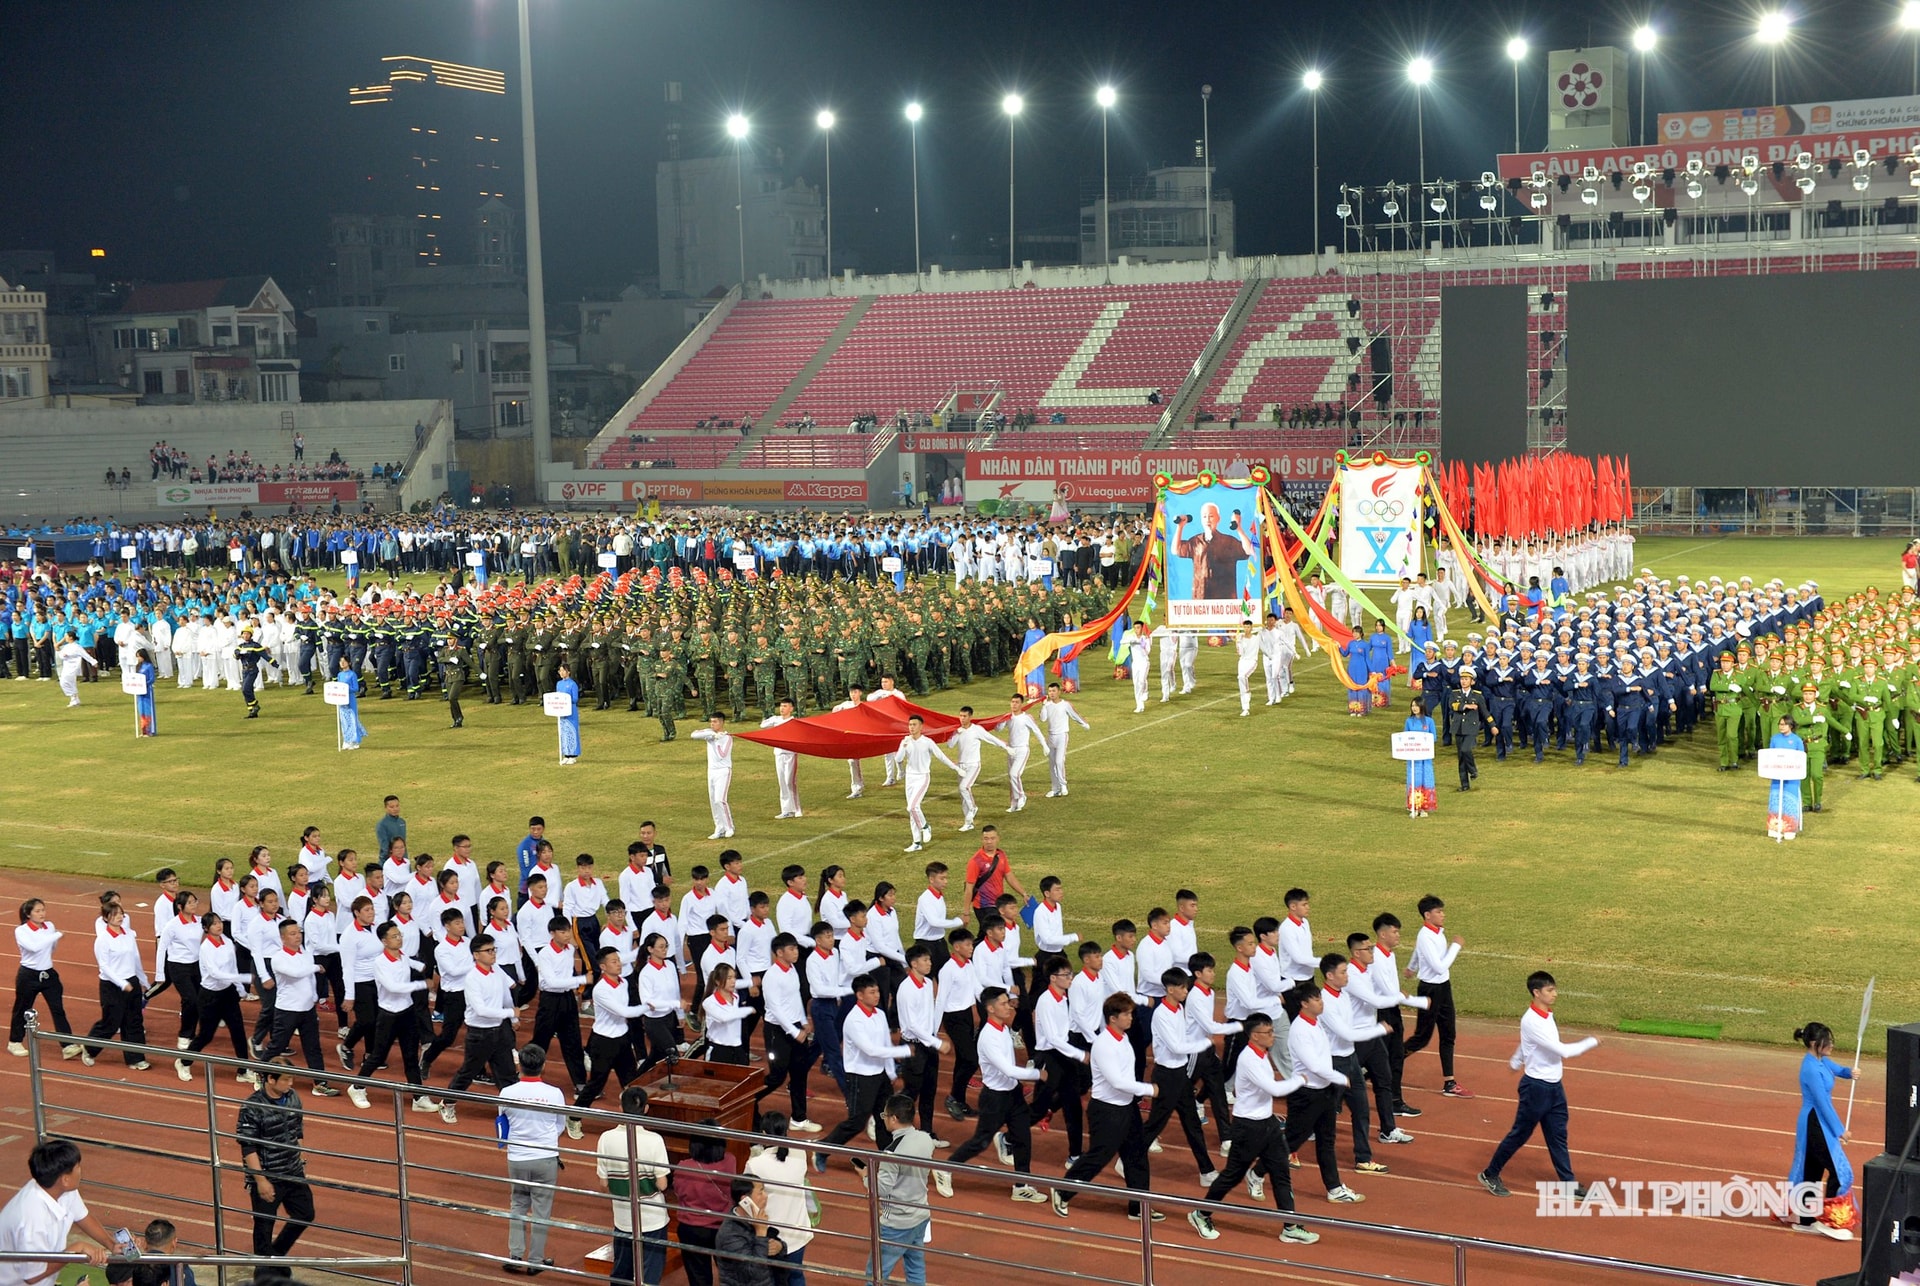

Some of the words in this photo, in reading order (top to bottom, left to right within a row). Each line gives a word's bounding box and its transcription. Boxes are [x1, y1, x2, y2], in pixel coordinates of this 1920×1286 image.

[980, 456, 1020, 475] NHÂN
[1024, 456, 1055, 475] DÂN
[1059, 455, 1107, 475] THÀNH
[1111, 453, 1142, 476] PHỐ
[1146, 457, 1198, 475] CHUNG
[1202, 457, 1228, 475] TAY
[1270, 454, 1292, 478] HỘ
[1300, 456, 1320, 478] SỰ
[229, 486, 251, 494] PHONG
[576, 482, 607, 496] VPF
[647, 485, 668, 497] FPT
[669, 484, 693, 499] Play
[703, 485, 728, 496] CHỨNG
[729, 485, 754, 496] KHOÁN
[755, 487, 782, 496] LPBANK
[807, 483, 862, 499] Kappa
[1078, 486, 1149, 499] V.League.VPF
[1355, 526, 1406, 575] X
